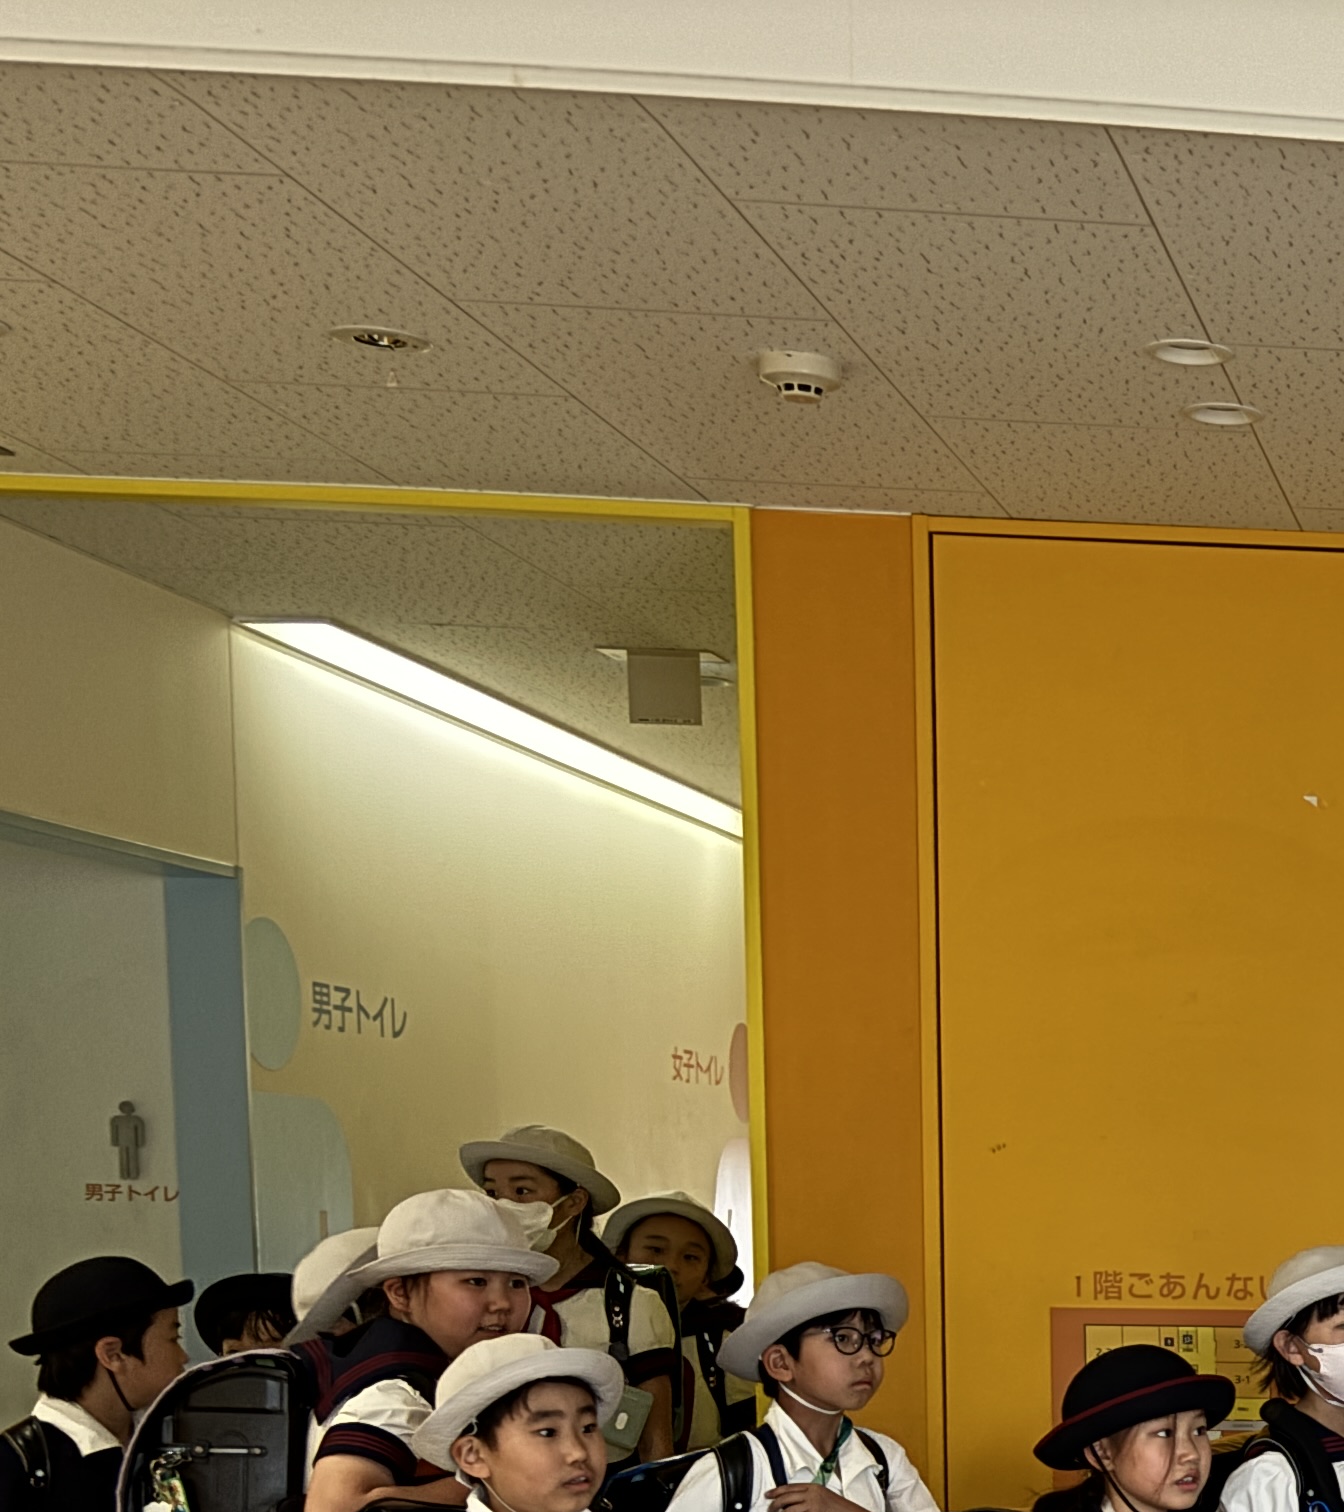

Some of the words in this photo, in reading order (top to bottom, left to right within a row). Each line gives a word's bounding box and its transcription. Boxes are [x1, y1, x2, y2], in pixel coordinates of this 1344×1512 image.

[311, 981, 408, 1039] 男子トイレ
[671, 1046, 725, 1086] 女子トイレ
[84, 1183, 180, 1203] 男子トイレ
